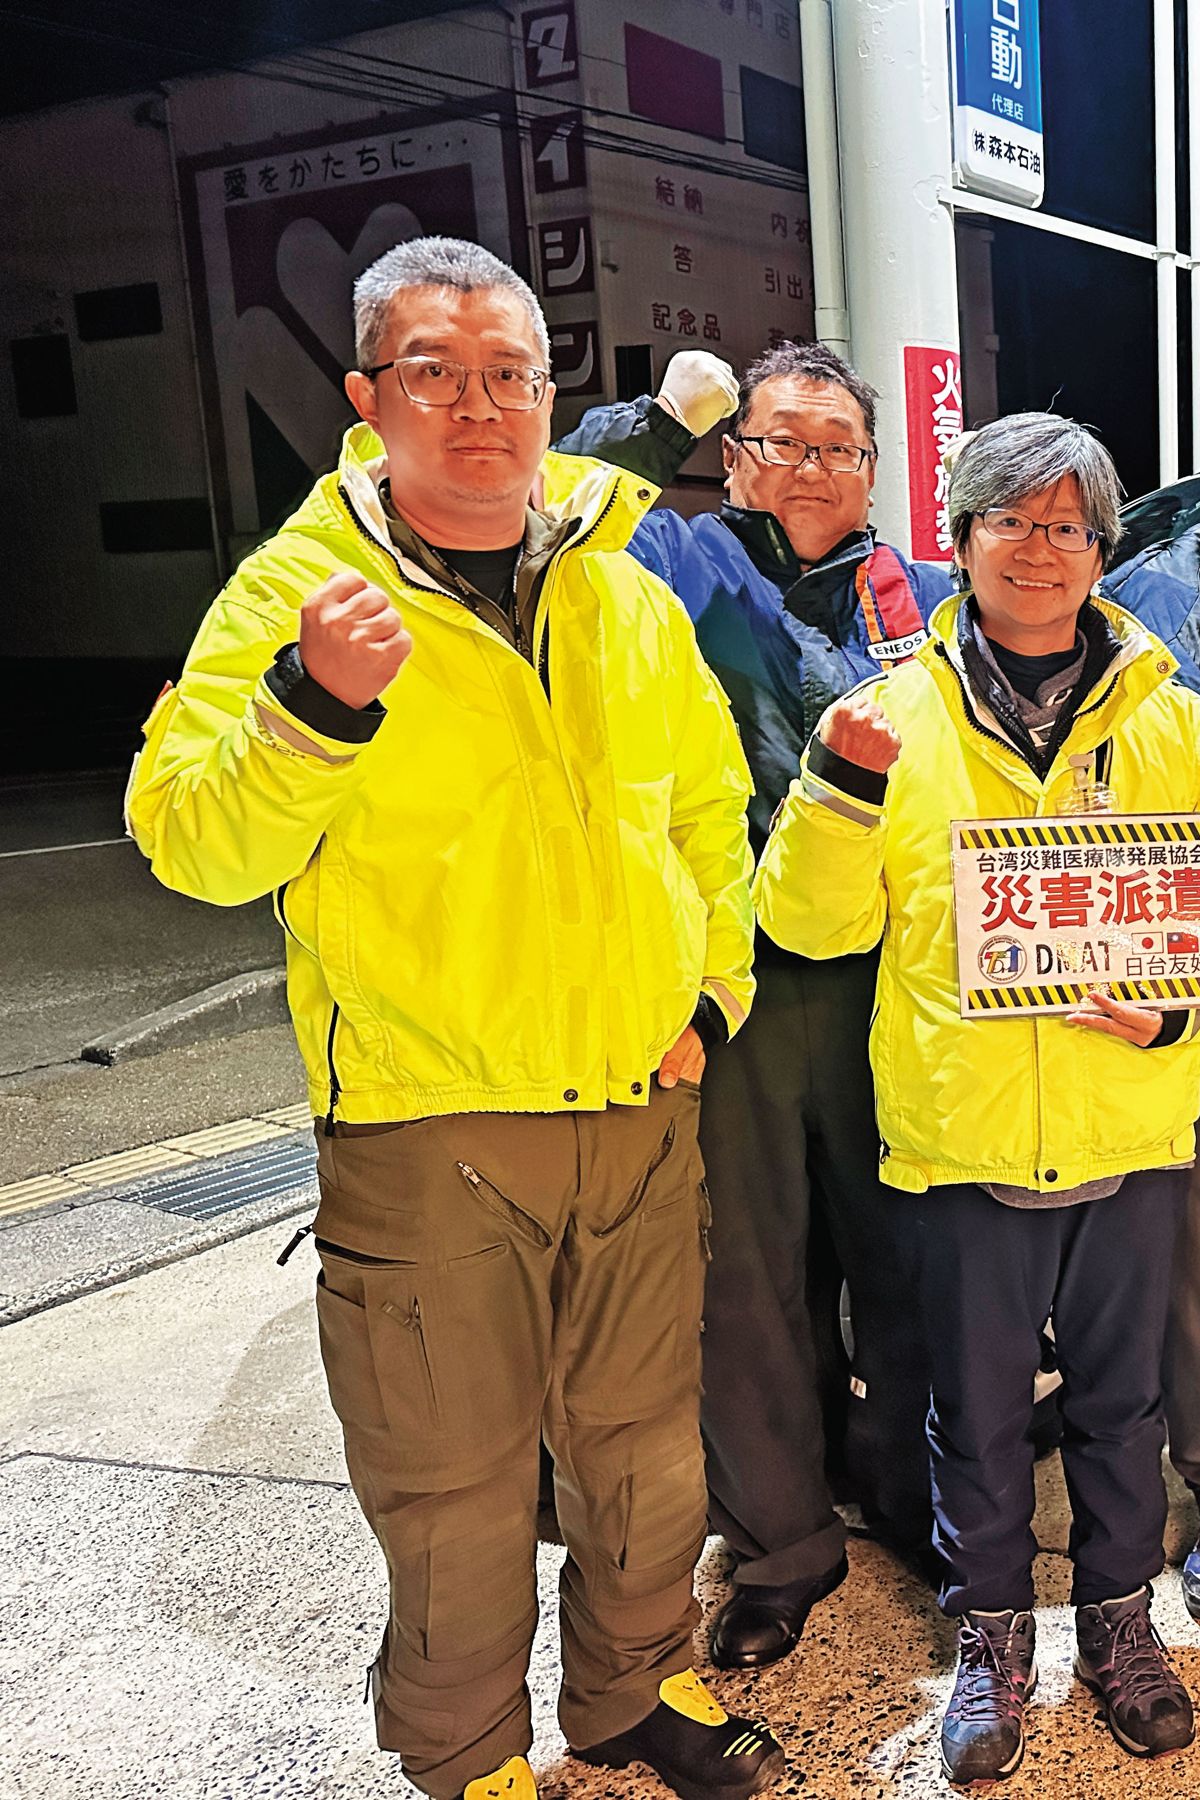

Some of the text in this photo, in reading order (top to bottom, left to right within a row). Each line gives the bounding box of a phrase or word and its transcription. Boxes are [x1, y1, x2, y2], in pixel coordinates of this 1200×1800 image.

[991, 93, 1024, 122] 代理店
[655, 175, 704, 215] 結納
[651, 302, 722, 341] 記念品
[874, 636, 922, 656] ENEOS
